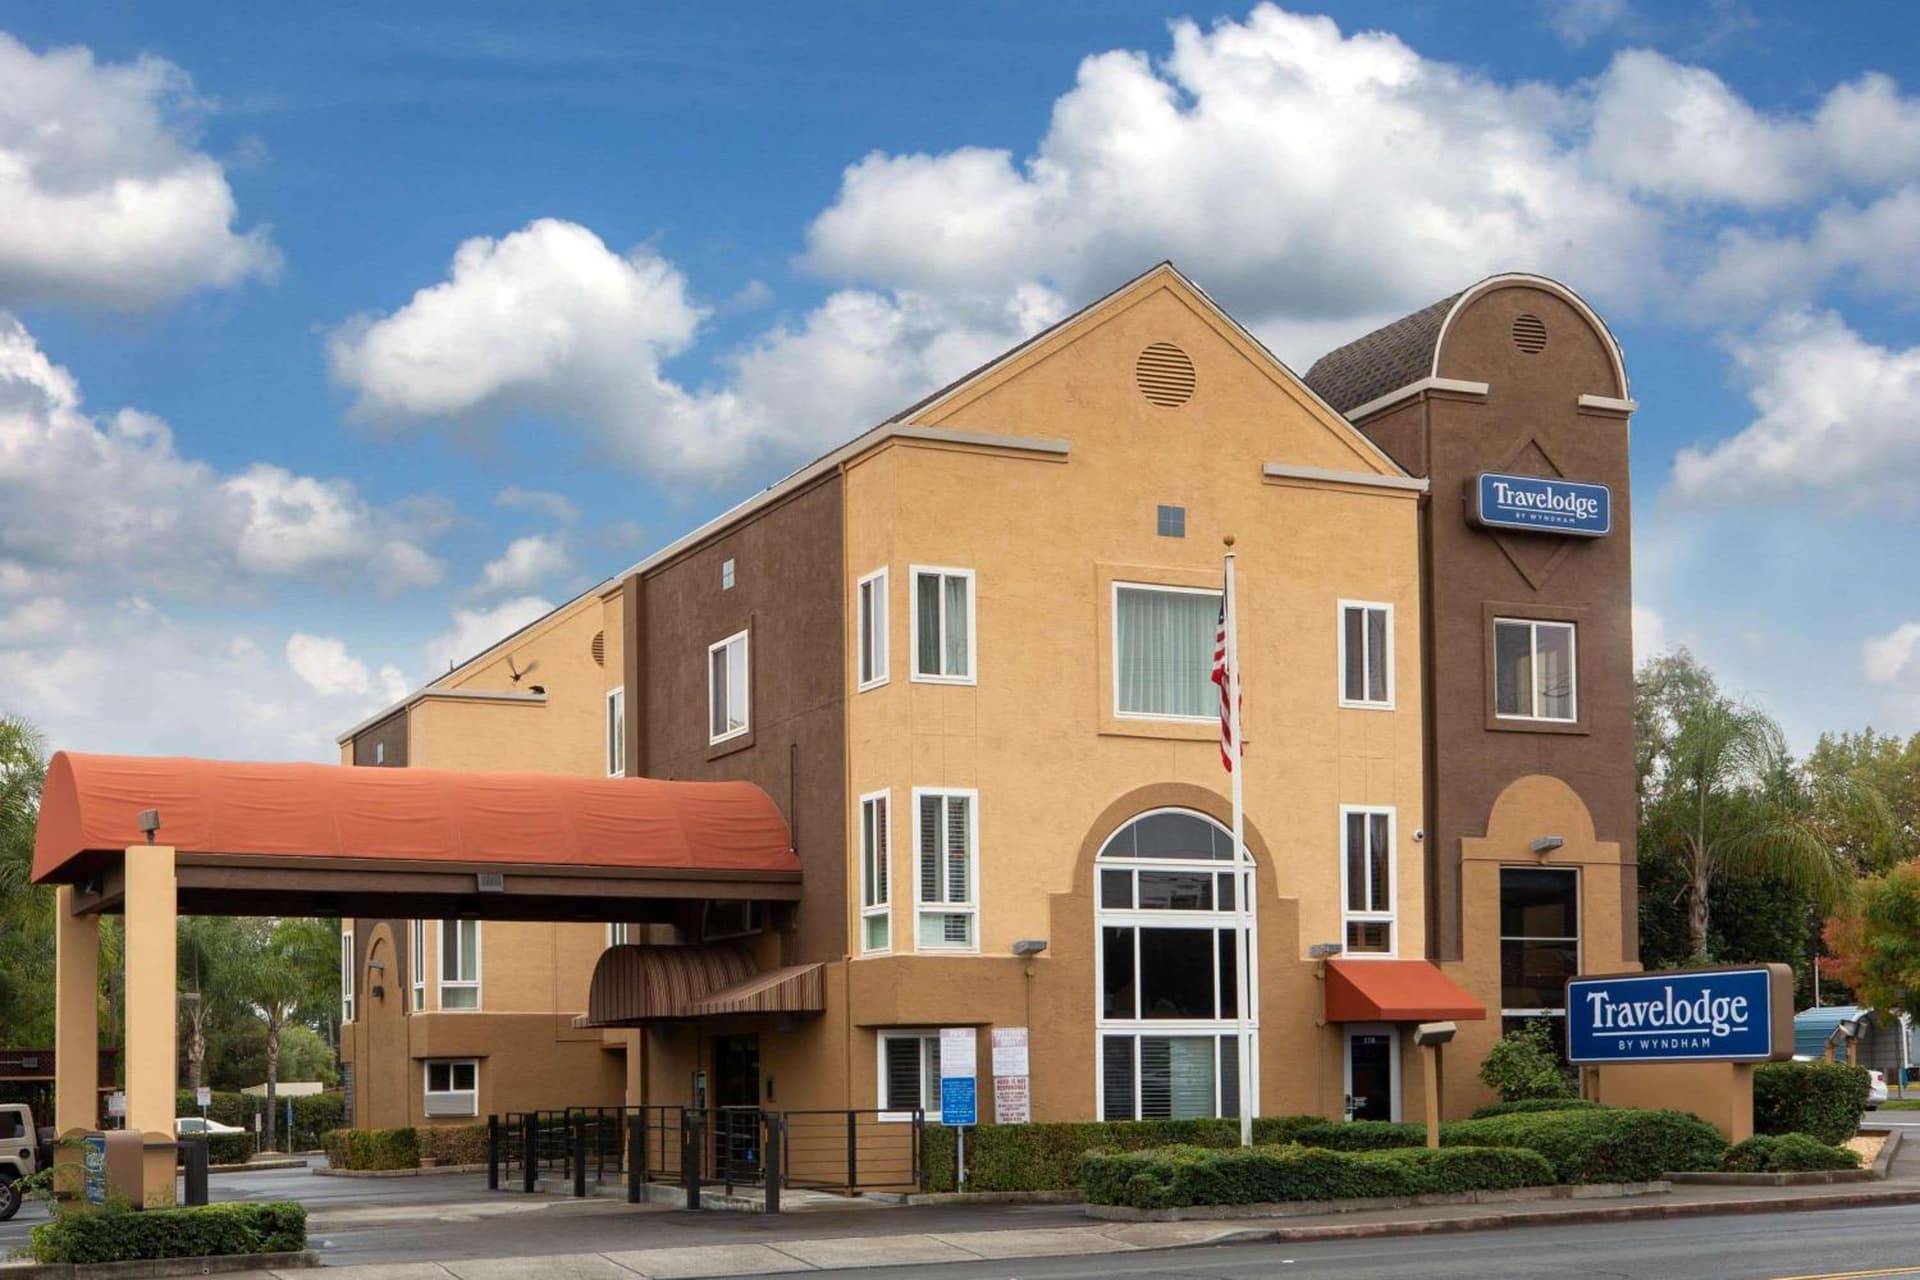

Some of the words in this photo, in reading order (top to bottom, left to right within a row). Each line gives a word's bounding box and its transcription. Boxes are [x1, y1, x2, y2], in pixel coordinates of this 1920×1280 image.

[1493, 482, 1598, 519] Travelodge
[1586, 986, 1748, 1037] Travelodge
[1619, 1040, 1633, 1050] BY
[1640, 1037, 1711, 1049] WYNDHAM
